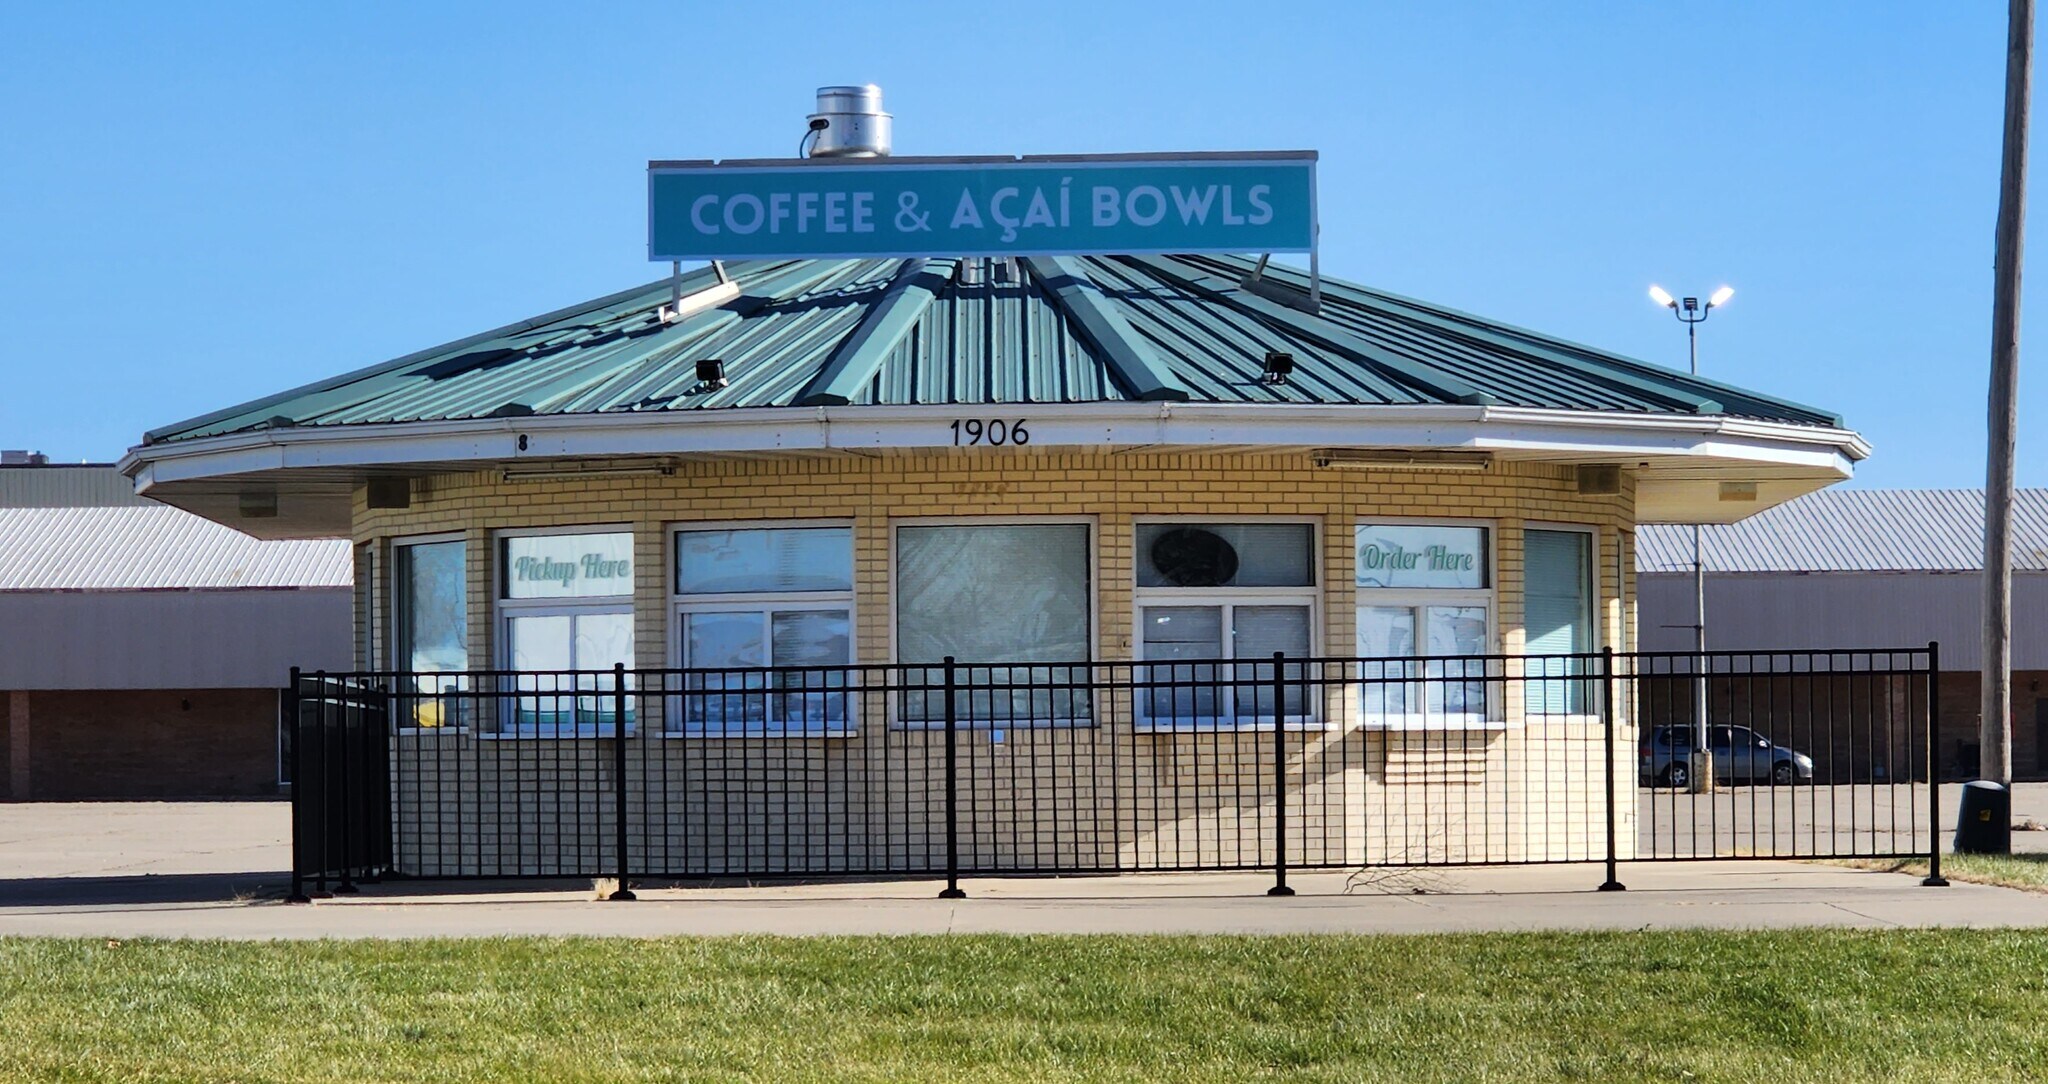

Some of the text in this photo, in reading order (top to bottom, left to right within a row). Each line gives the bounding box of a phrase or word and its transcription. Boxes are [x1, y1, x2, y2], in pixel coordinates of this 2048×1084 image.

[691, 176, 1274, 242] COFFEE & AÇAÍ BOWLS
[950, 419, 1029, 446] 1906
[515, 553, 631, 587] Pickup Here
[1361, 544, 1474, 571] Order Here
